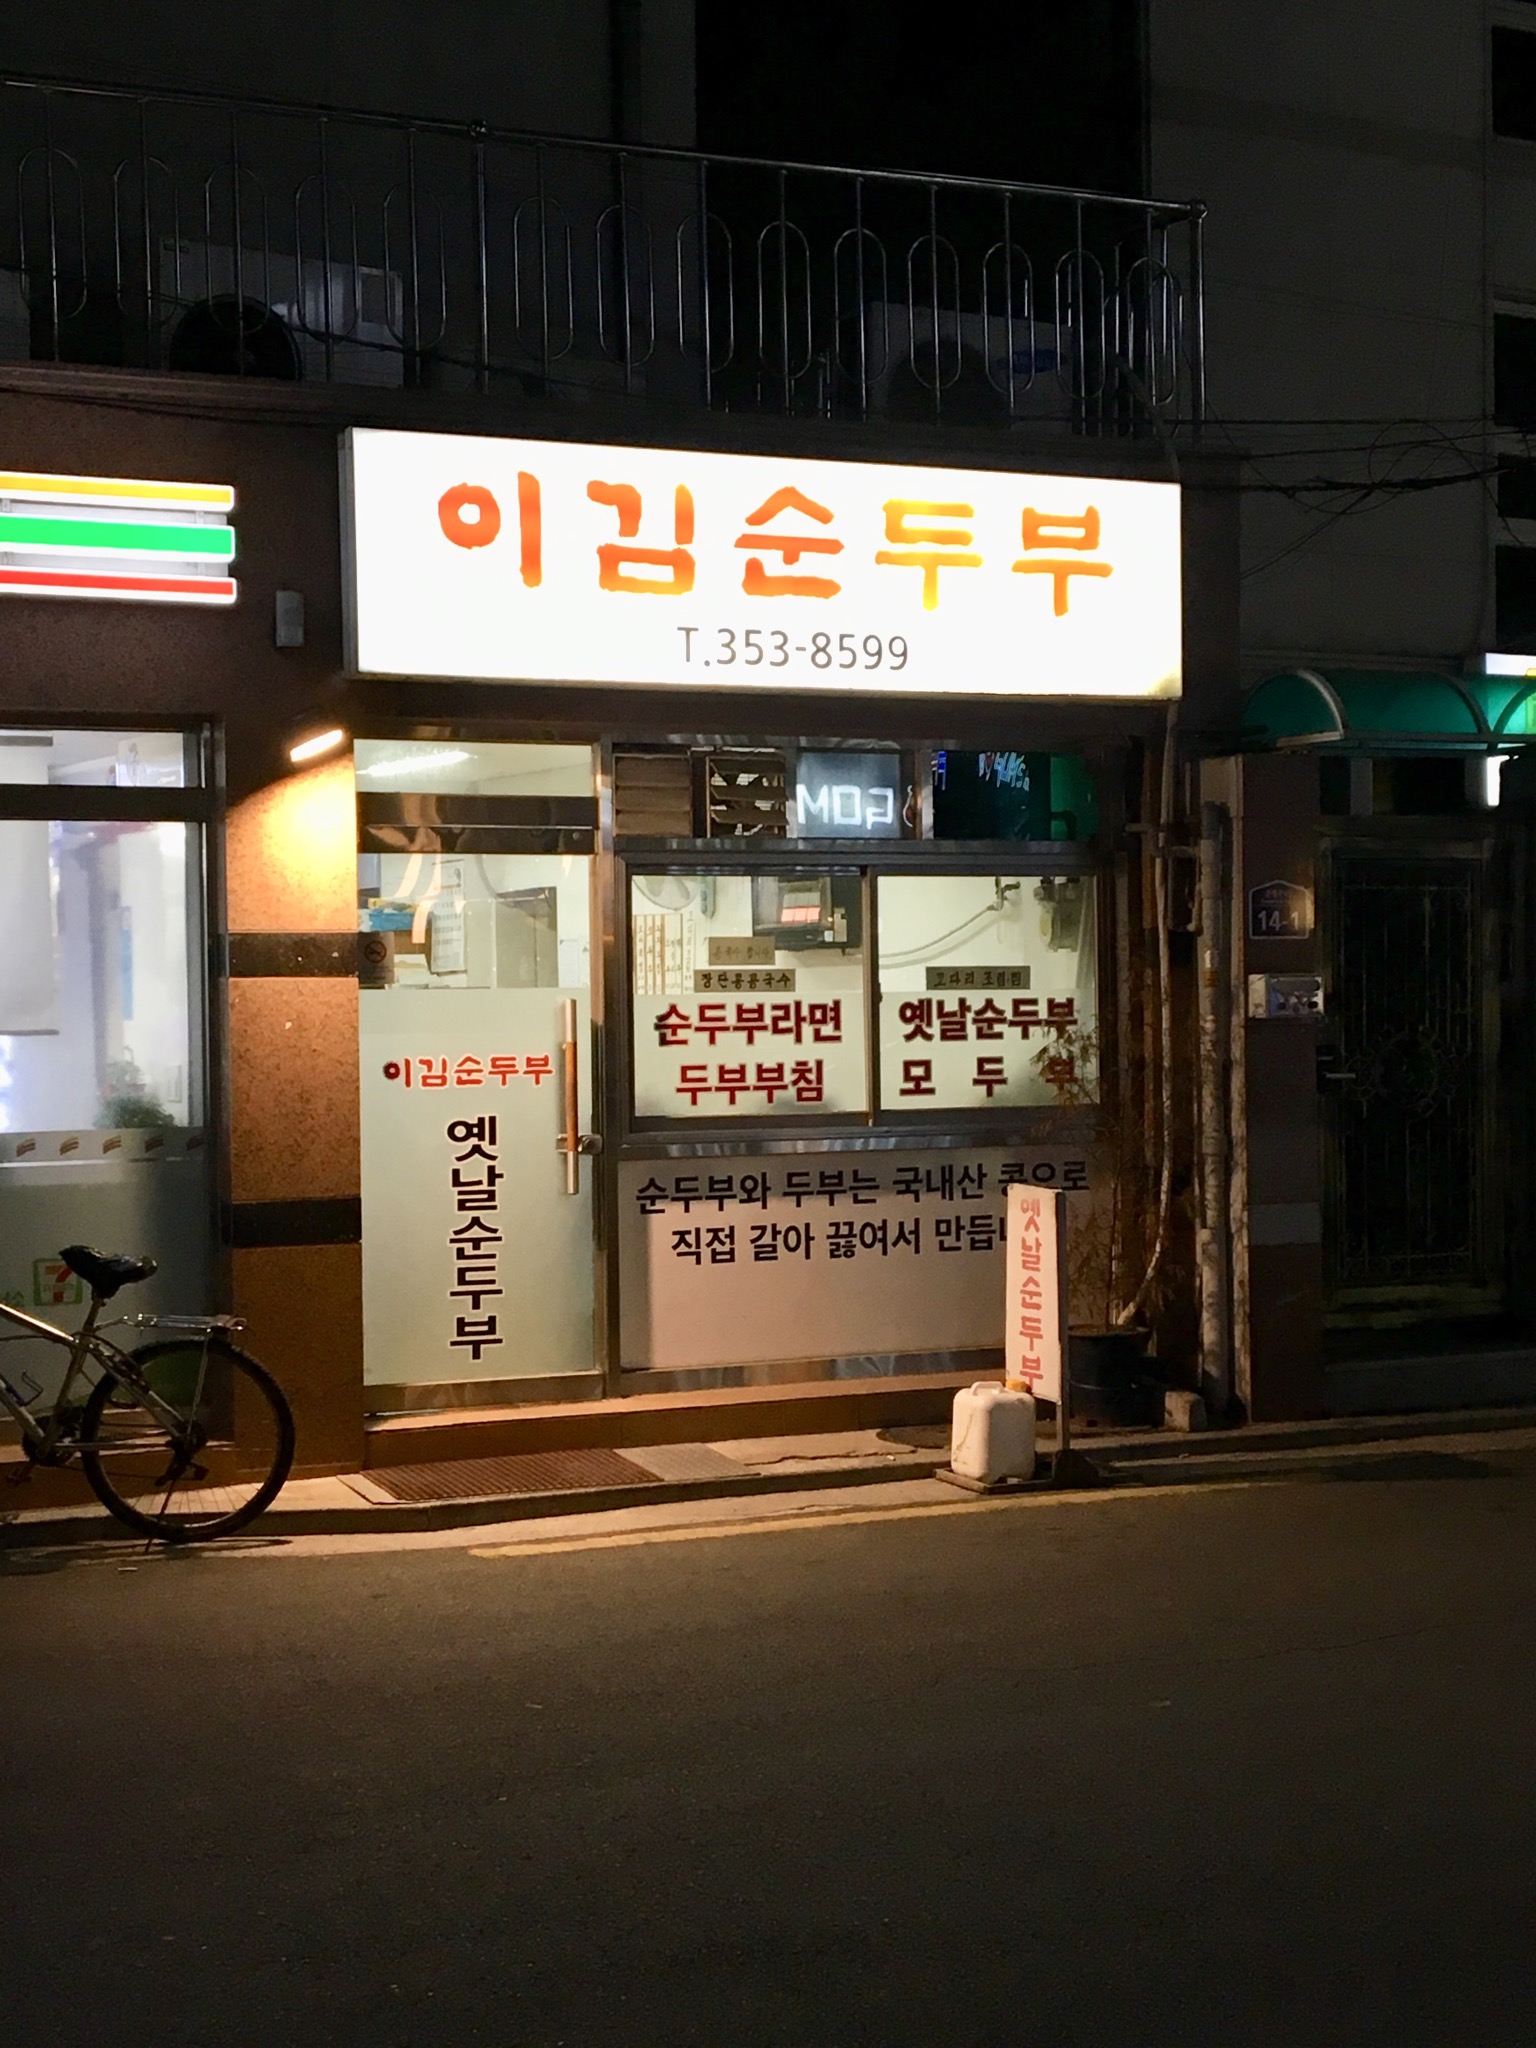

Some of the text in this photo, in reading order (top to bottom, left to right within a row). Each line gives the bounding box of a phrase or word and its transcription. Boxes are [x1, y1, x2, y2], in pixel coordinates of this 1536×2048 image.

[438, 471, 1114, 617] 이김순두부
[677, 627, 908, 671] T.353-8599
[1257, 910, 1299, 931] 14-1
[654, 999, 842, 1046] 순두부라면
[899, 997, 1078, 1042] 옛날순두부
[384, 1055, 554, 1087] 이김순두부
[676, 1059, 824, 1106] 두부부침
[636, 1172, 772, 1214] 순두부와
[783, 1169, 880, 1207] 두부는
[893, 1163, 988, 1202] 국내산
[447, 1115, 504, 1361] 옛날순두부
[671, 1226, 736, 1265] 직접
[750, 1222, 815, 1260] 갈아
[826, 1218, 921, 1259] 끓여서
[1019, 1198, 1044, 1392] 옛날순두부
